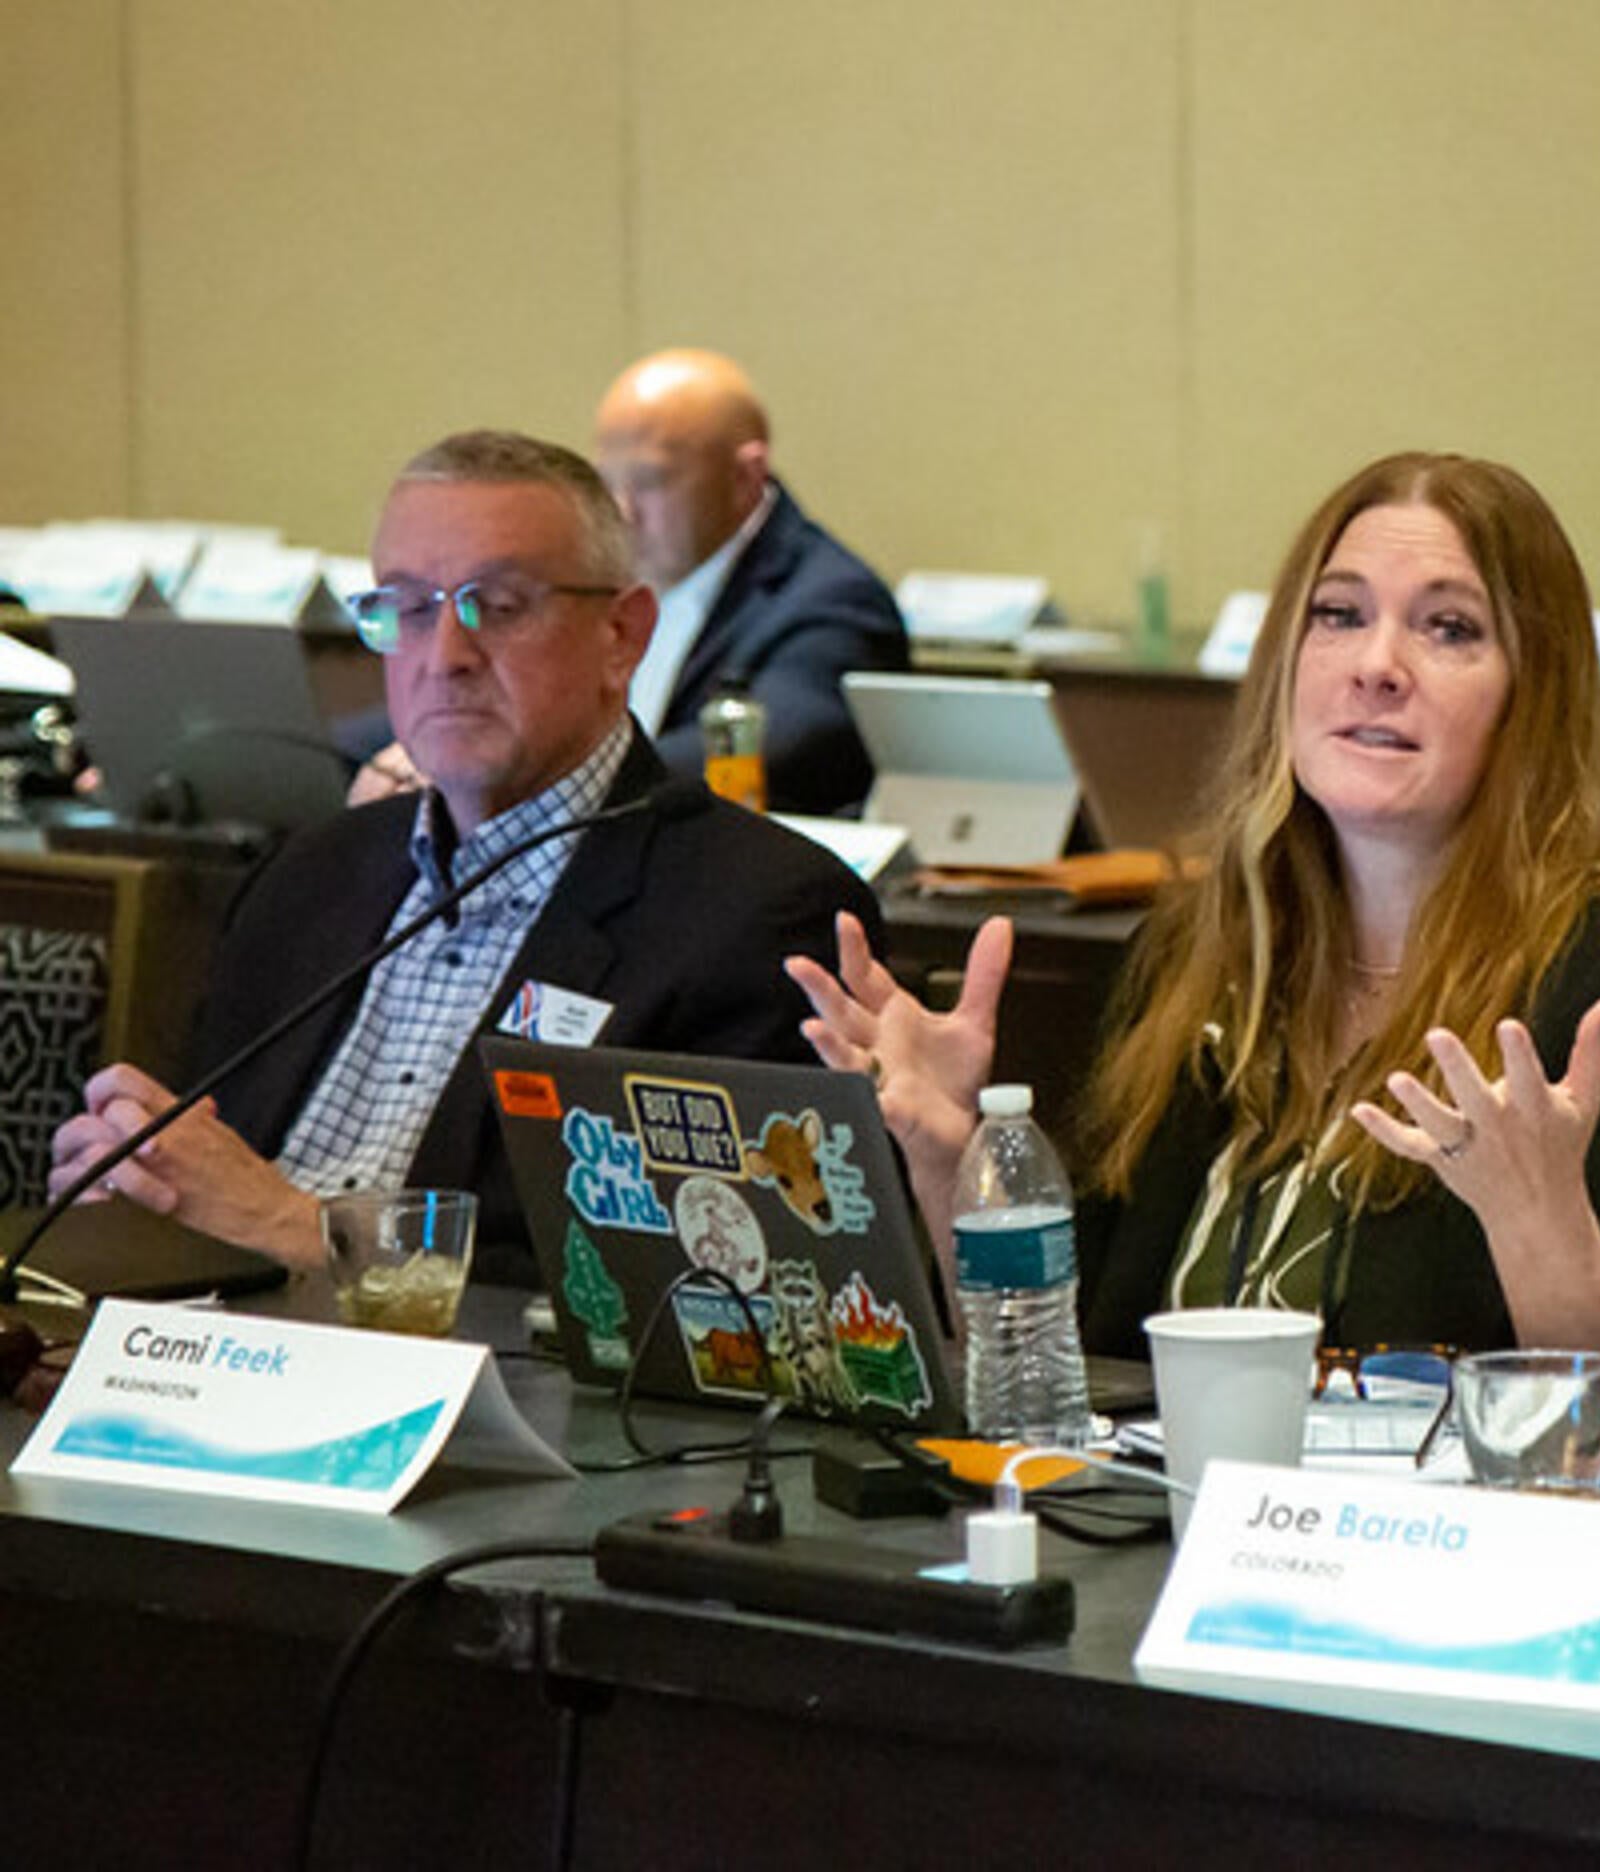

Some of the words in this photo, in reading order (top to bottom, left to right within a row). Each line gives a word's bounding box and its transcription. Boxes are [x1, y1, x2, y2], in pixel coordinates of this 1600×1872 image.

[124, 1325, 213, 1364] Cami
[213, 1334, 290, 1376] Feek
[105, 1374, 200, 1399] WASHINGTON
[1246, 1493, 1321, 1533] Joe
[1335, 1503, 1469, 1551] Barela
[1231, 1551, 1345, 1580] COLORADO
